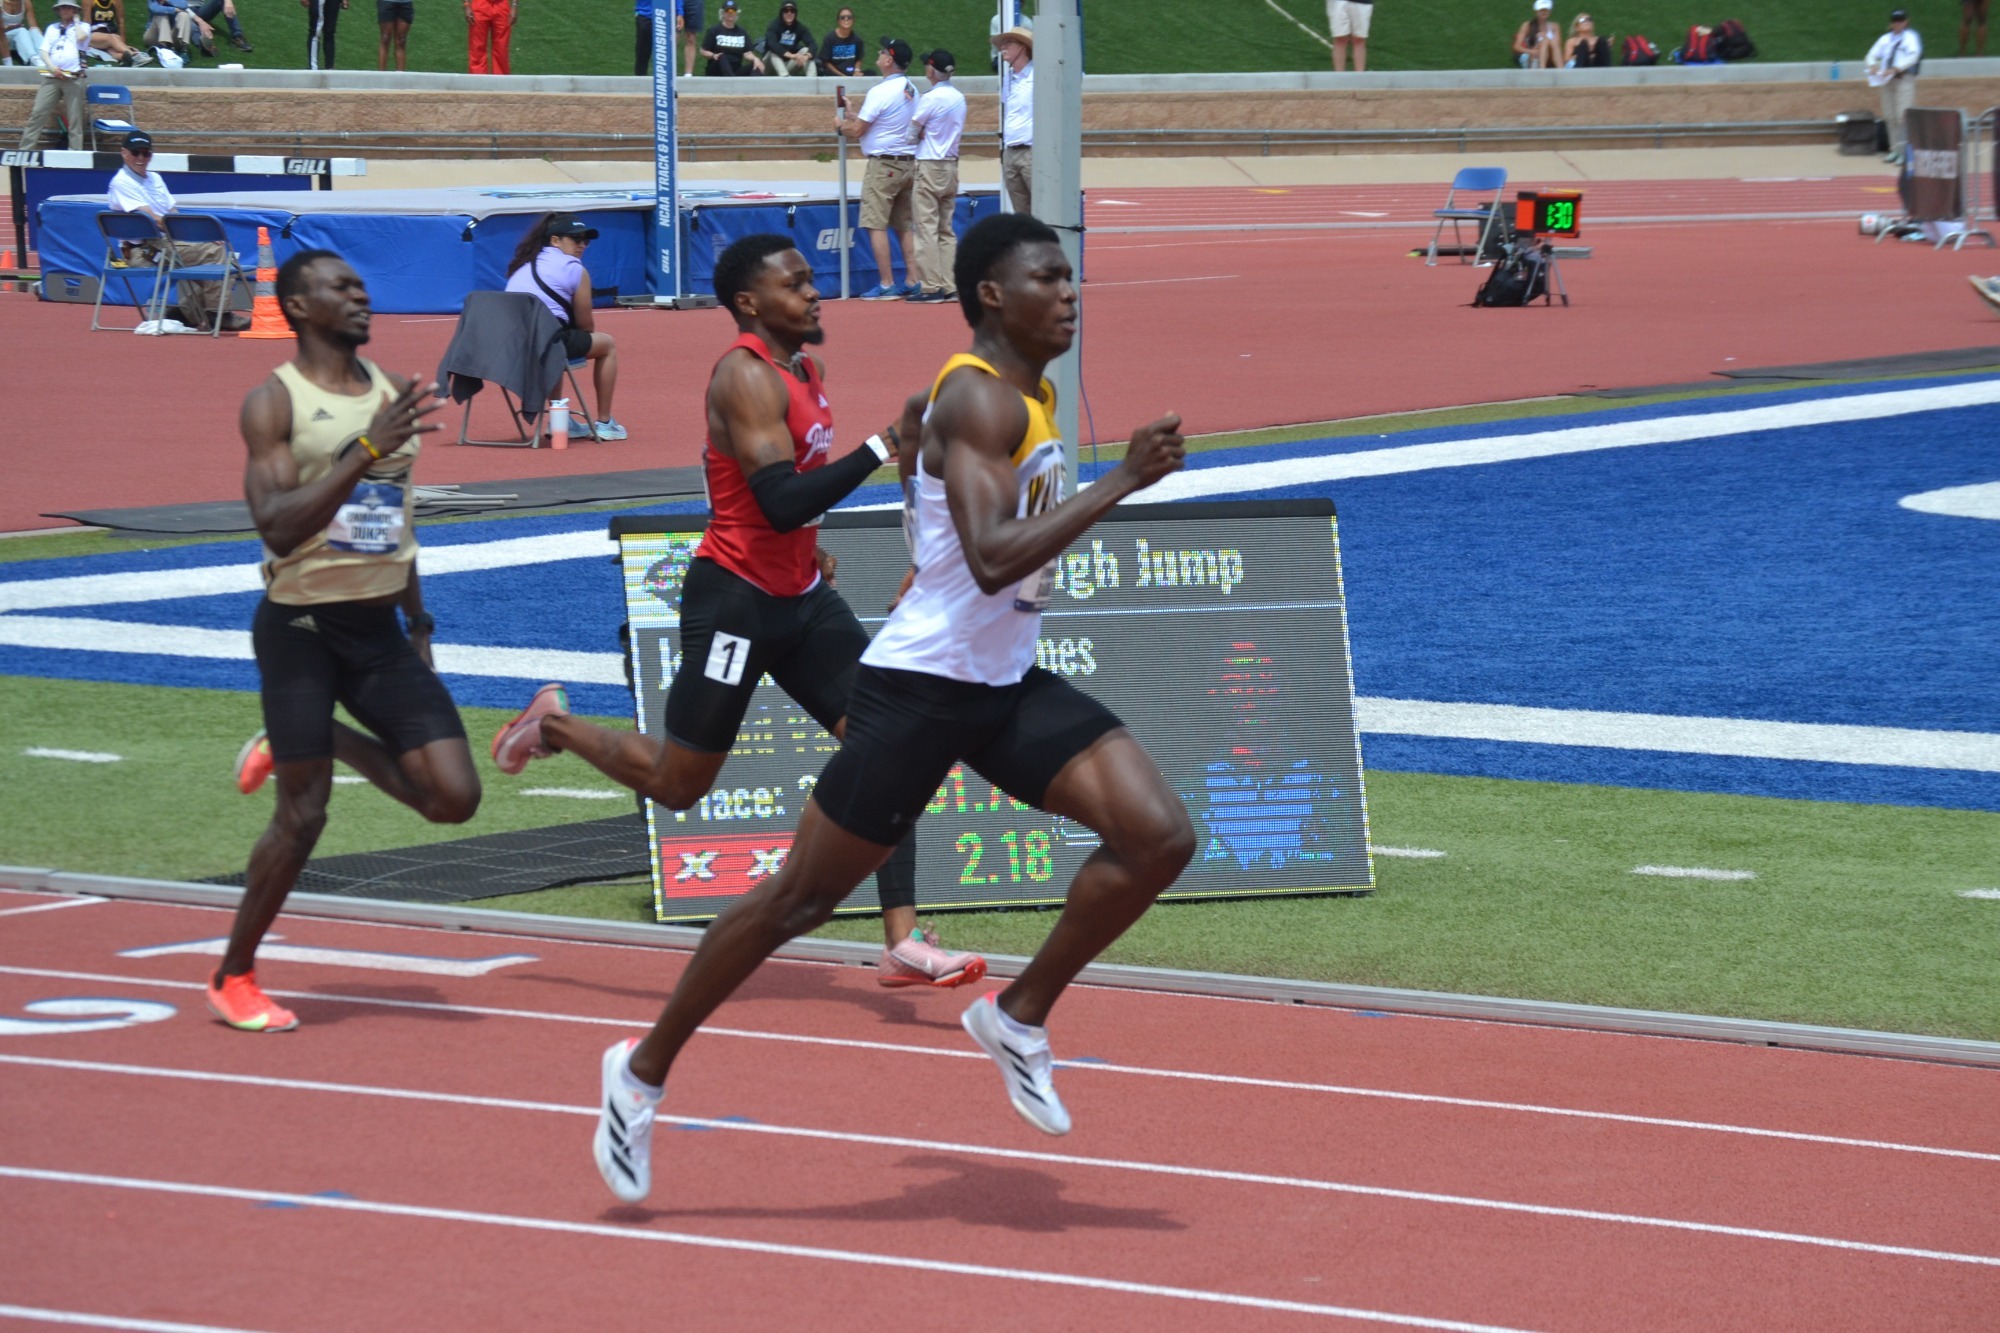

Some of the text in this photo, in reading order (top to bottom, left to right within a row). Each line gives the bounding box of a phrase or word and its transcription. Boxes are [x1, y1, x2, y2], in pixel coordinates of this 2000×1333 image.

[655, 8, 671, 227] NCAA TRACK & FIELD CHAMPIONSHIPS
[1, 151, 41, 167] GILL
[287, 158, 327, 174] GILL
[816, 228, 856, 250] GIL
[662, 248, 670, 274] GILL
[1136, 538, 1244, 595] Jump
[722, 640, 738, 680] 1
[675, 787, 787, 822] lace:
[956, 830, 1053, 885] 2.18
